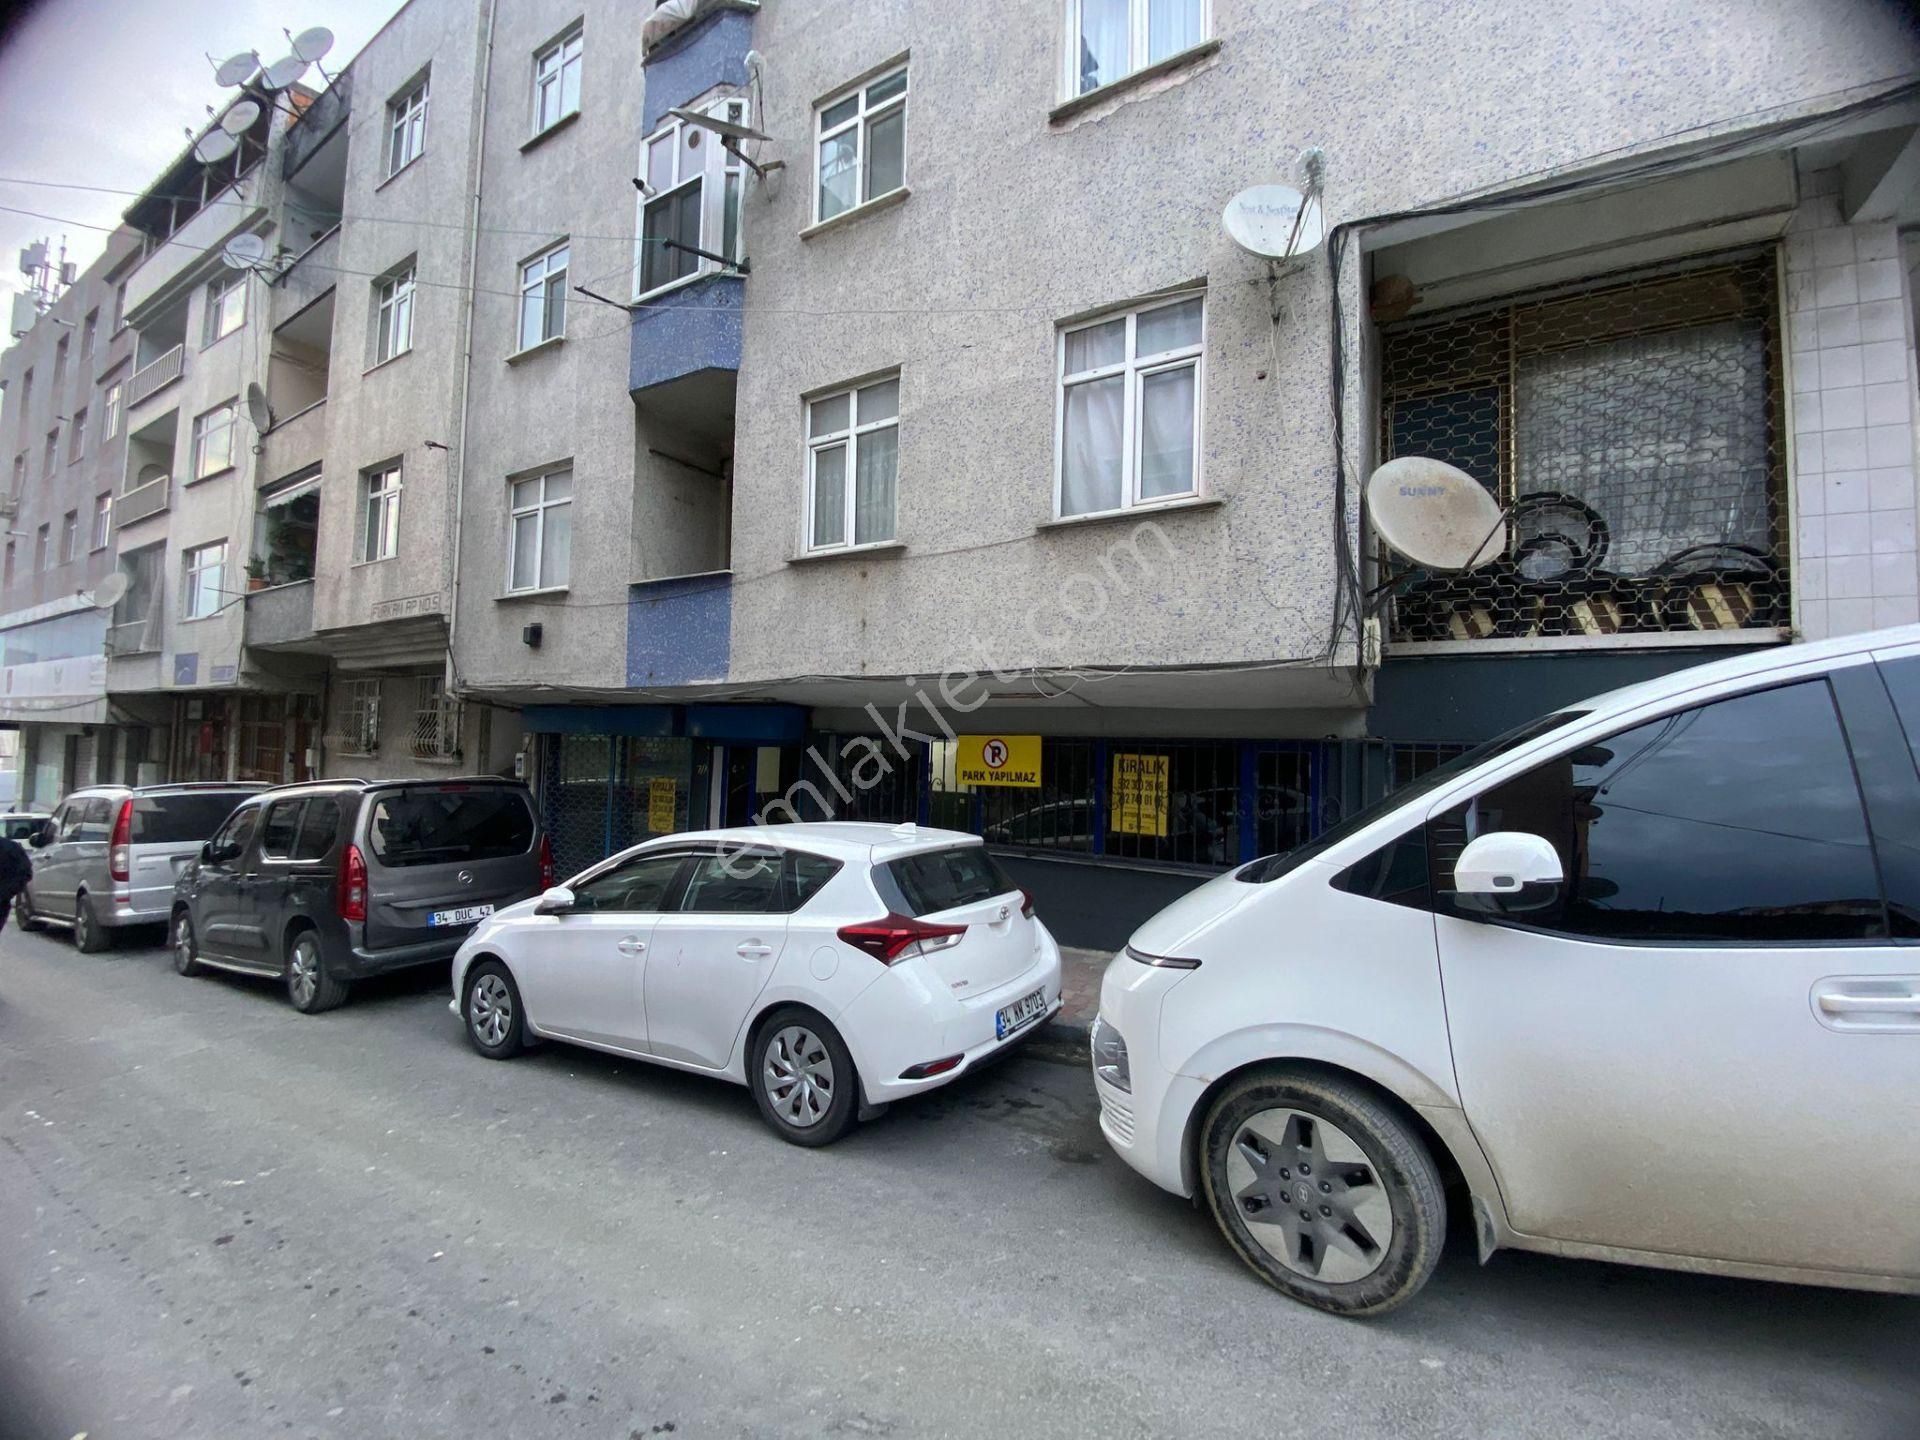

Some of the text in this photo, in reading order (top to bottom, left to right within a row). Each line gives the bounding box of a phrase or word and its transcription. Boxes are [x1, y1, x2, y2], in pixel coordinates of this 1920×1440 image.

[1399, 485, 1446, 497] SUNNY
[962, 770, 1036, 783] PARK YAPILMAZ
[435, 912, 448, 923] 34
[455, 908, 473, 921] DUC
[479, 906, 491, 917] 42
[1000, 1009, 1012, 1029] 34
